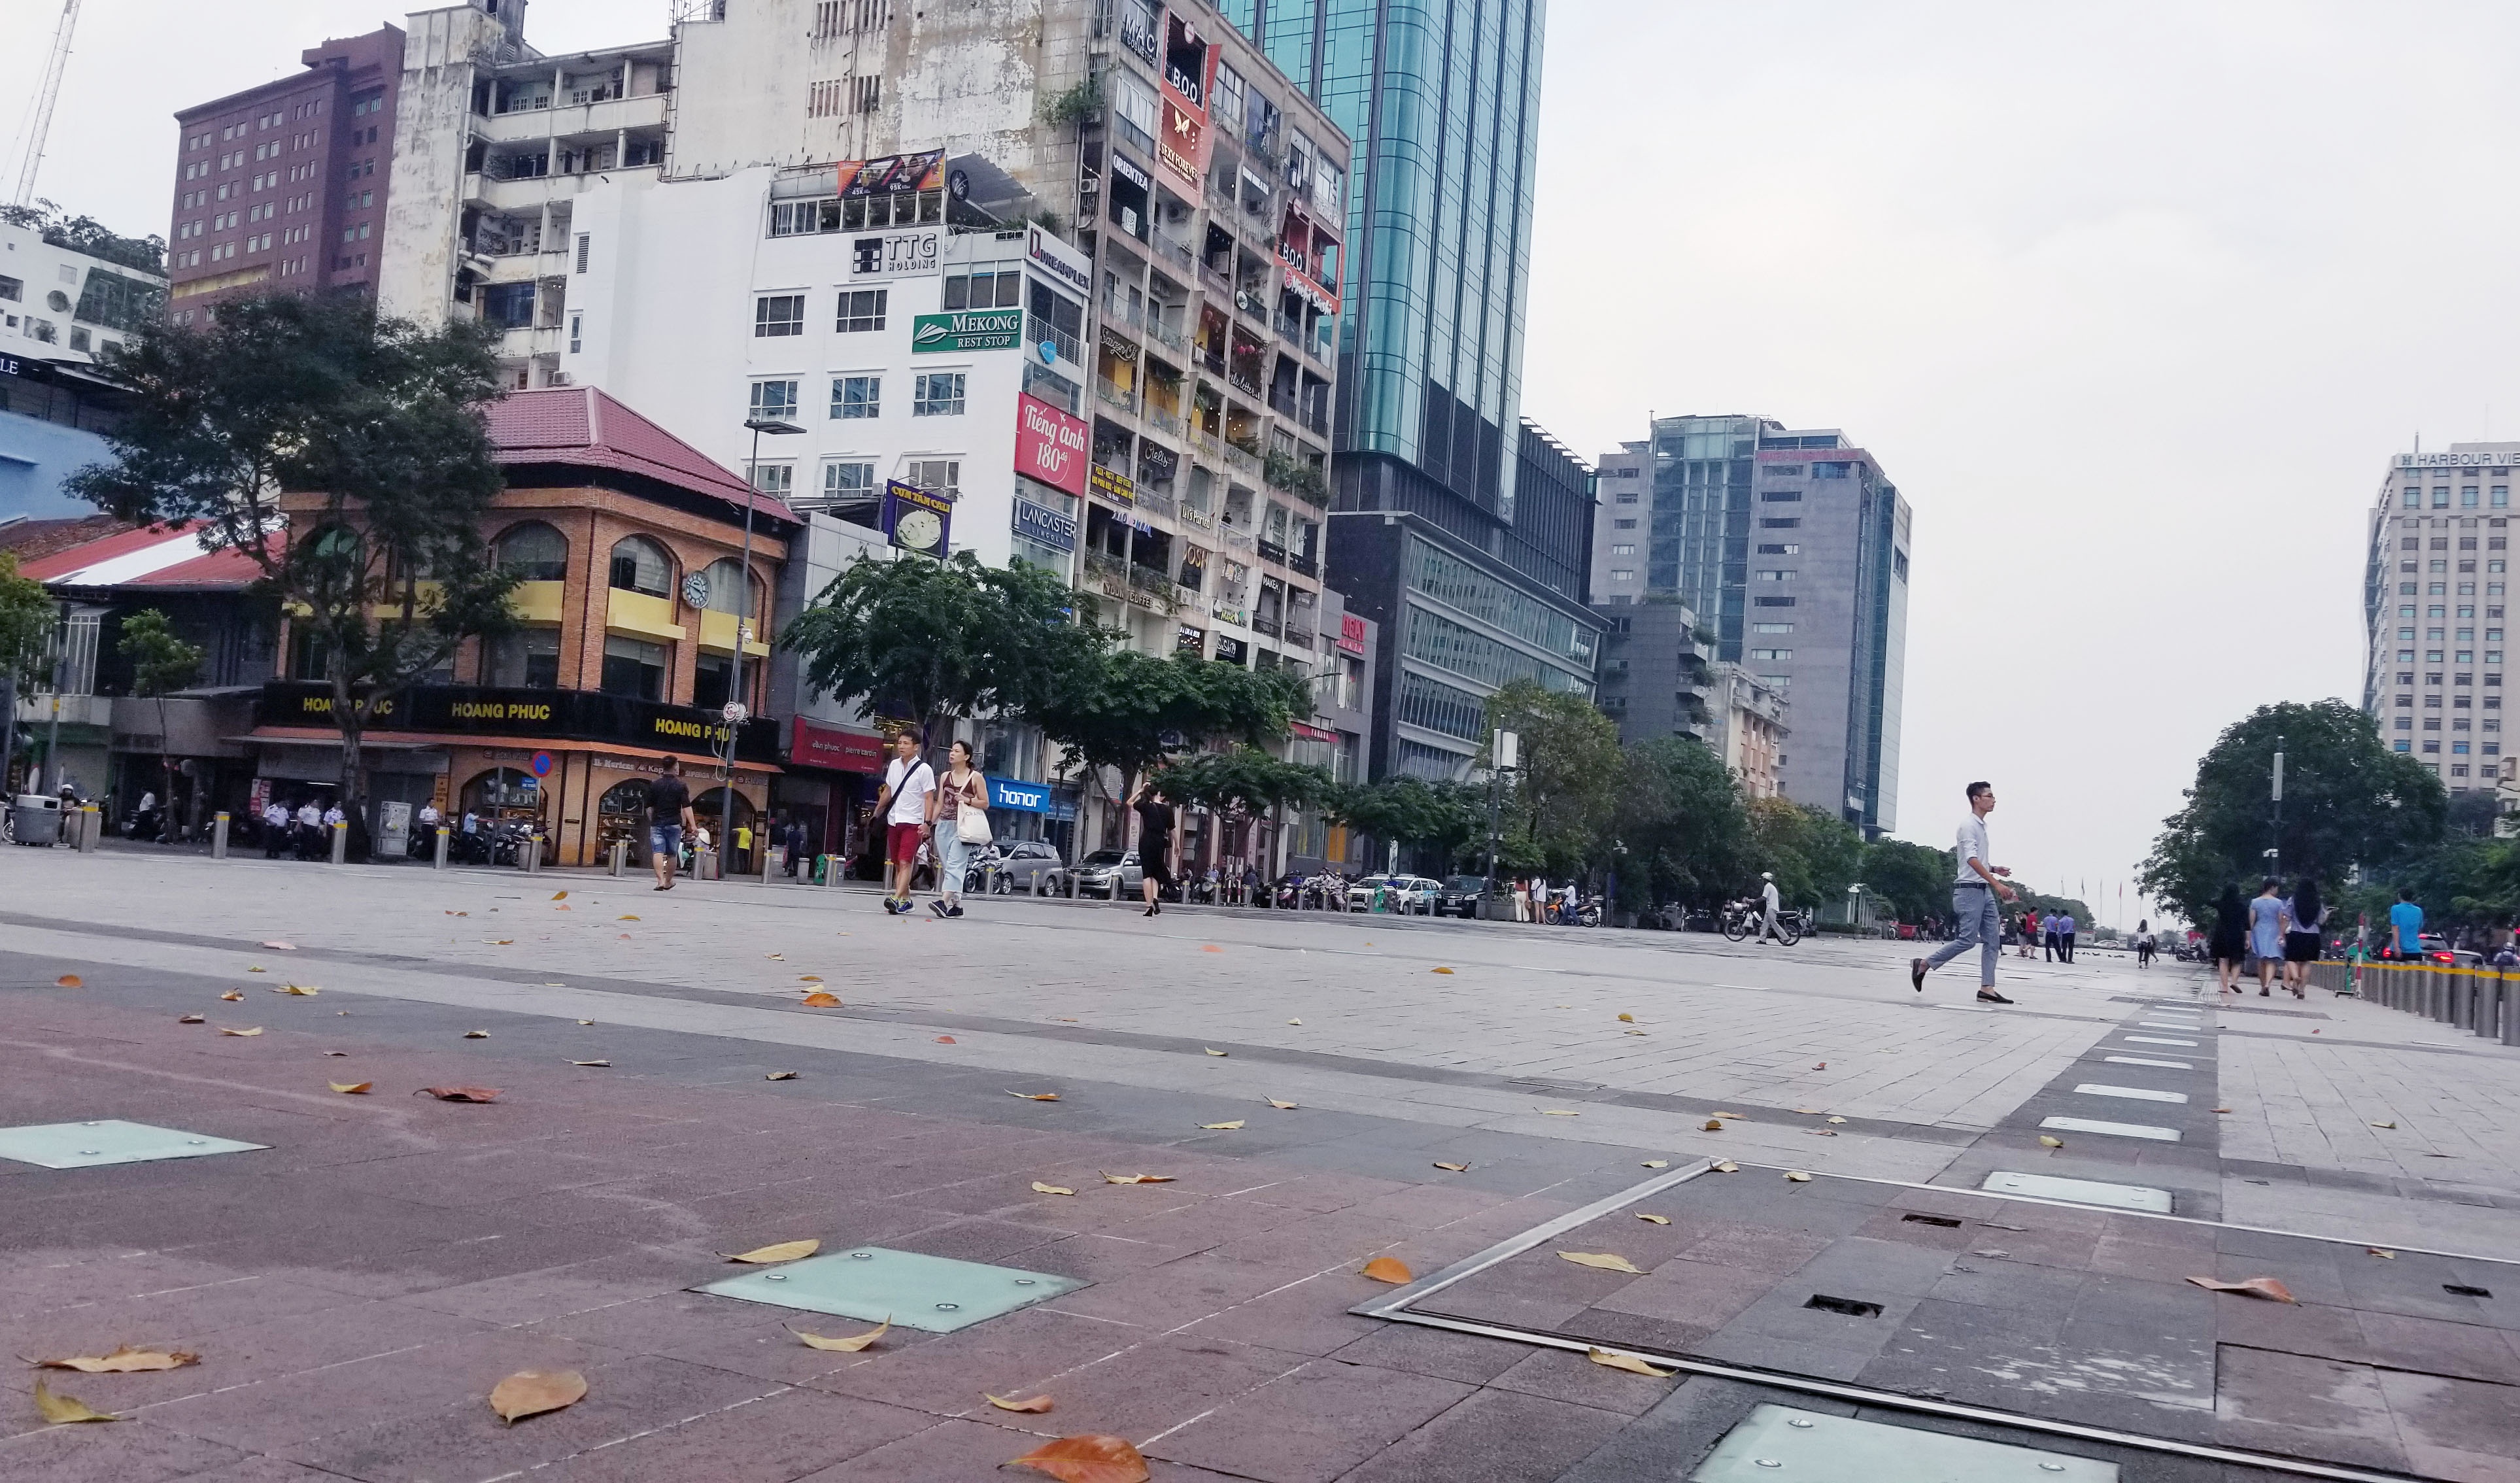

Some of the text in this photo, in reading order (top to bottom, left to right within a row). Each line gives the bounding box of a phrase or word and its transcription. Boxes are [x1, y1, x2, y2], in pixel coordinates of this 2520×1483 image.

[1127, 36, 1155, 65] COSMETICS
[1173, 67, 1197, 103] BOO
[1114, 155, 1148, 191] ORIENTEA
[1161, 143, 1198, 181] SEXY FOREVER
[885, 233, 937, 260] TTG
[1283, 242, 1302, 271] BOO
[889, 259, 936, 271] HOLDING
[1040, 249, 1090, 290] DREAMPLEX
[951, 315, 1019, 333] MEKONG
[957, 335, 1010, 348] REST STOP
[0, 358, 18, 375] LE
[1025, 404, 1057, 445] Tiếng
[1037, 442, 1060, 472] 180
[2417, 453, 2492, 466] HARBOUR
[930, 499, 950, 513] CALI
[1022, 503, 1076, 539] LANCASTER
[1032, 526, 1064, 544] LINCOLN
[1183, 545, 1208, 570] OSH
[1263, 576, 1279, 590] MAKER
[1129, 591, 1153, 608] COFFEE
[1342, 614, 1367, 641] UCKY
[452, 702, 551, 720] HOANG PHUC
[655, 718, 734, 742] HOANG PHU
[648, 765, 666, 774] Kap
[999, 783, 1042, 808] honor
